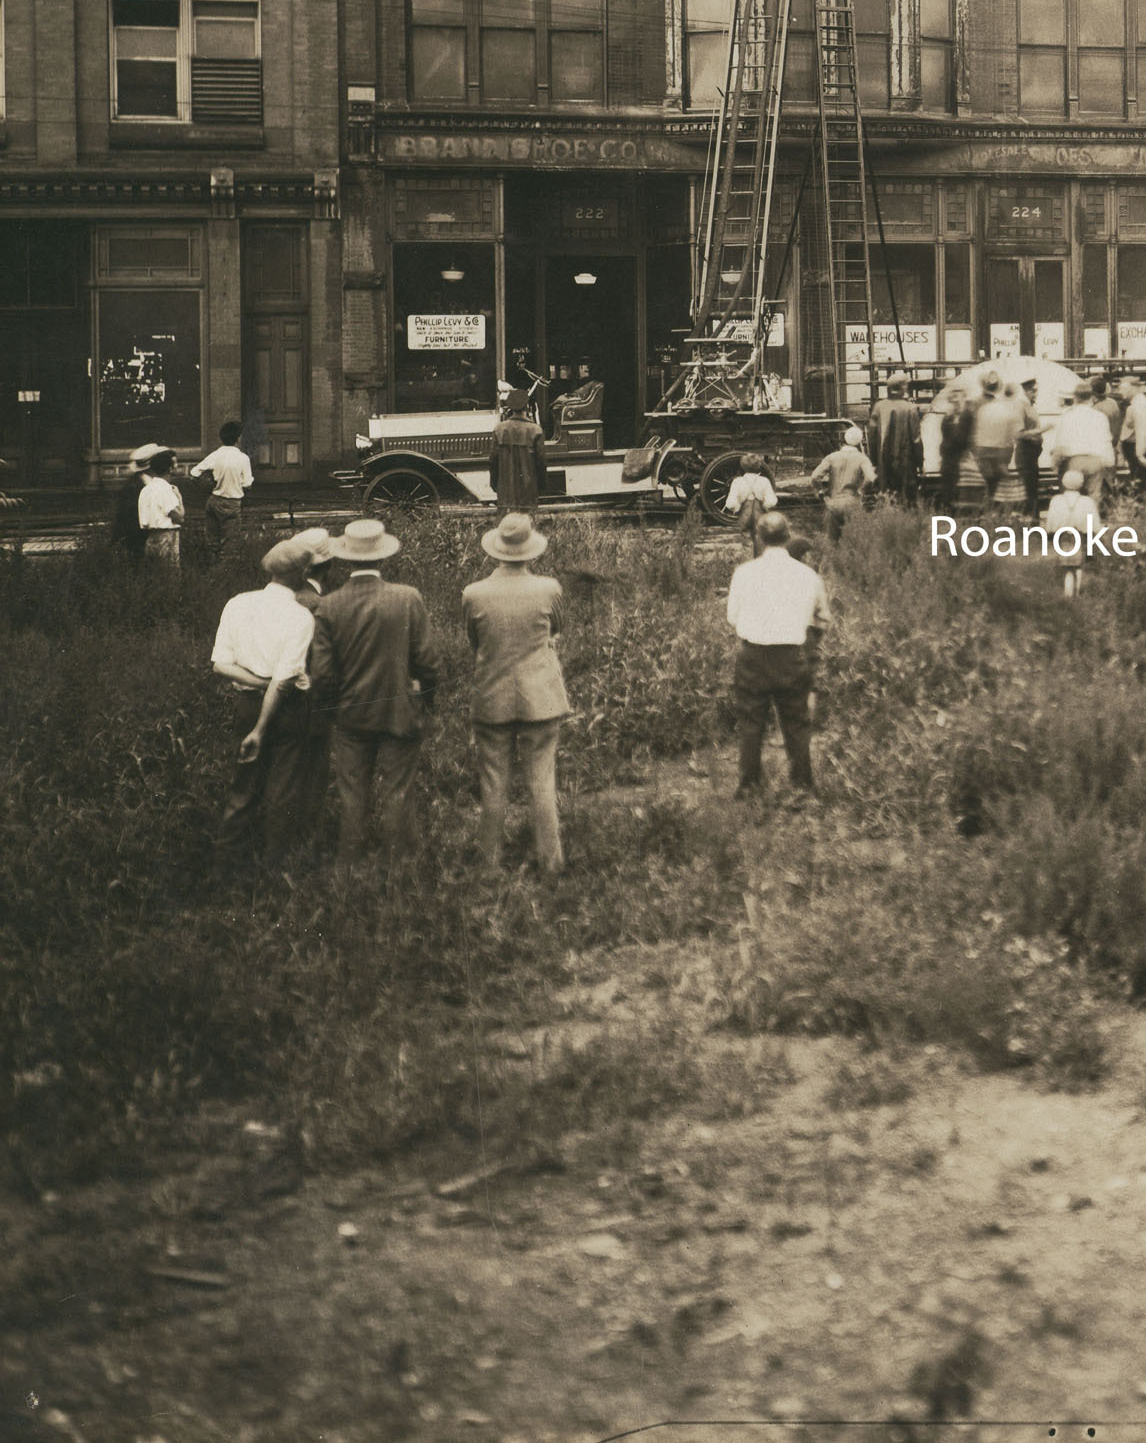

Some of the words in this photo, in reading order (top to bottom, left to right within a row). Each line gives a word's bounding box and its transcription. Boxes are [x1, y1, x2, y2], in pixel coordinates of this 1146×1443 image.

[575, 207, 604, 219] 222
[1012, 206, 1042, 218] 224
[443, 316, 463, 326] LEVY
[464, 316, 472, 326] &
[850, 331, 929, 344] WAEHOUSES
